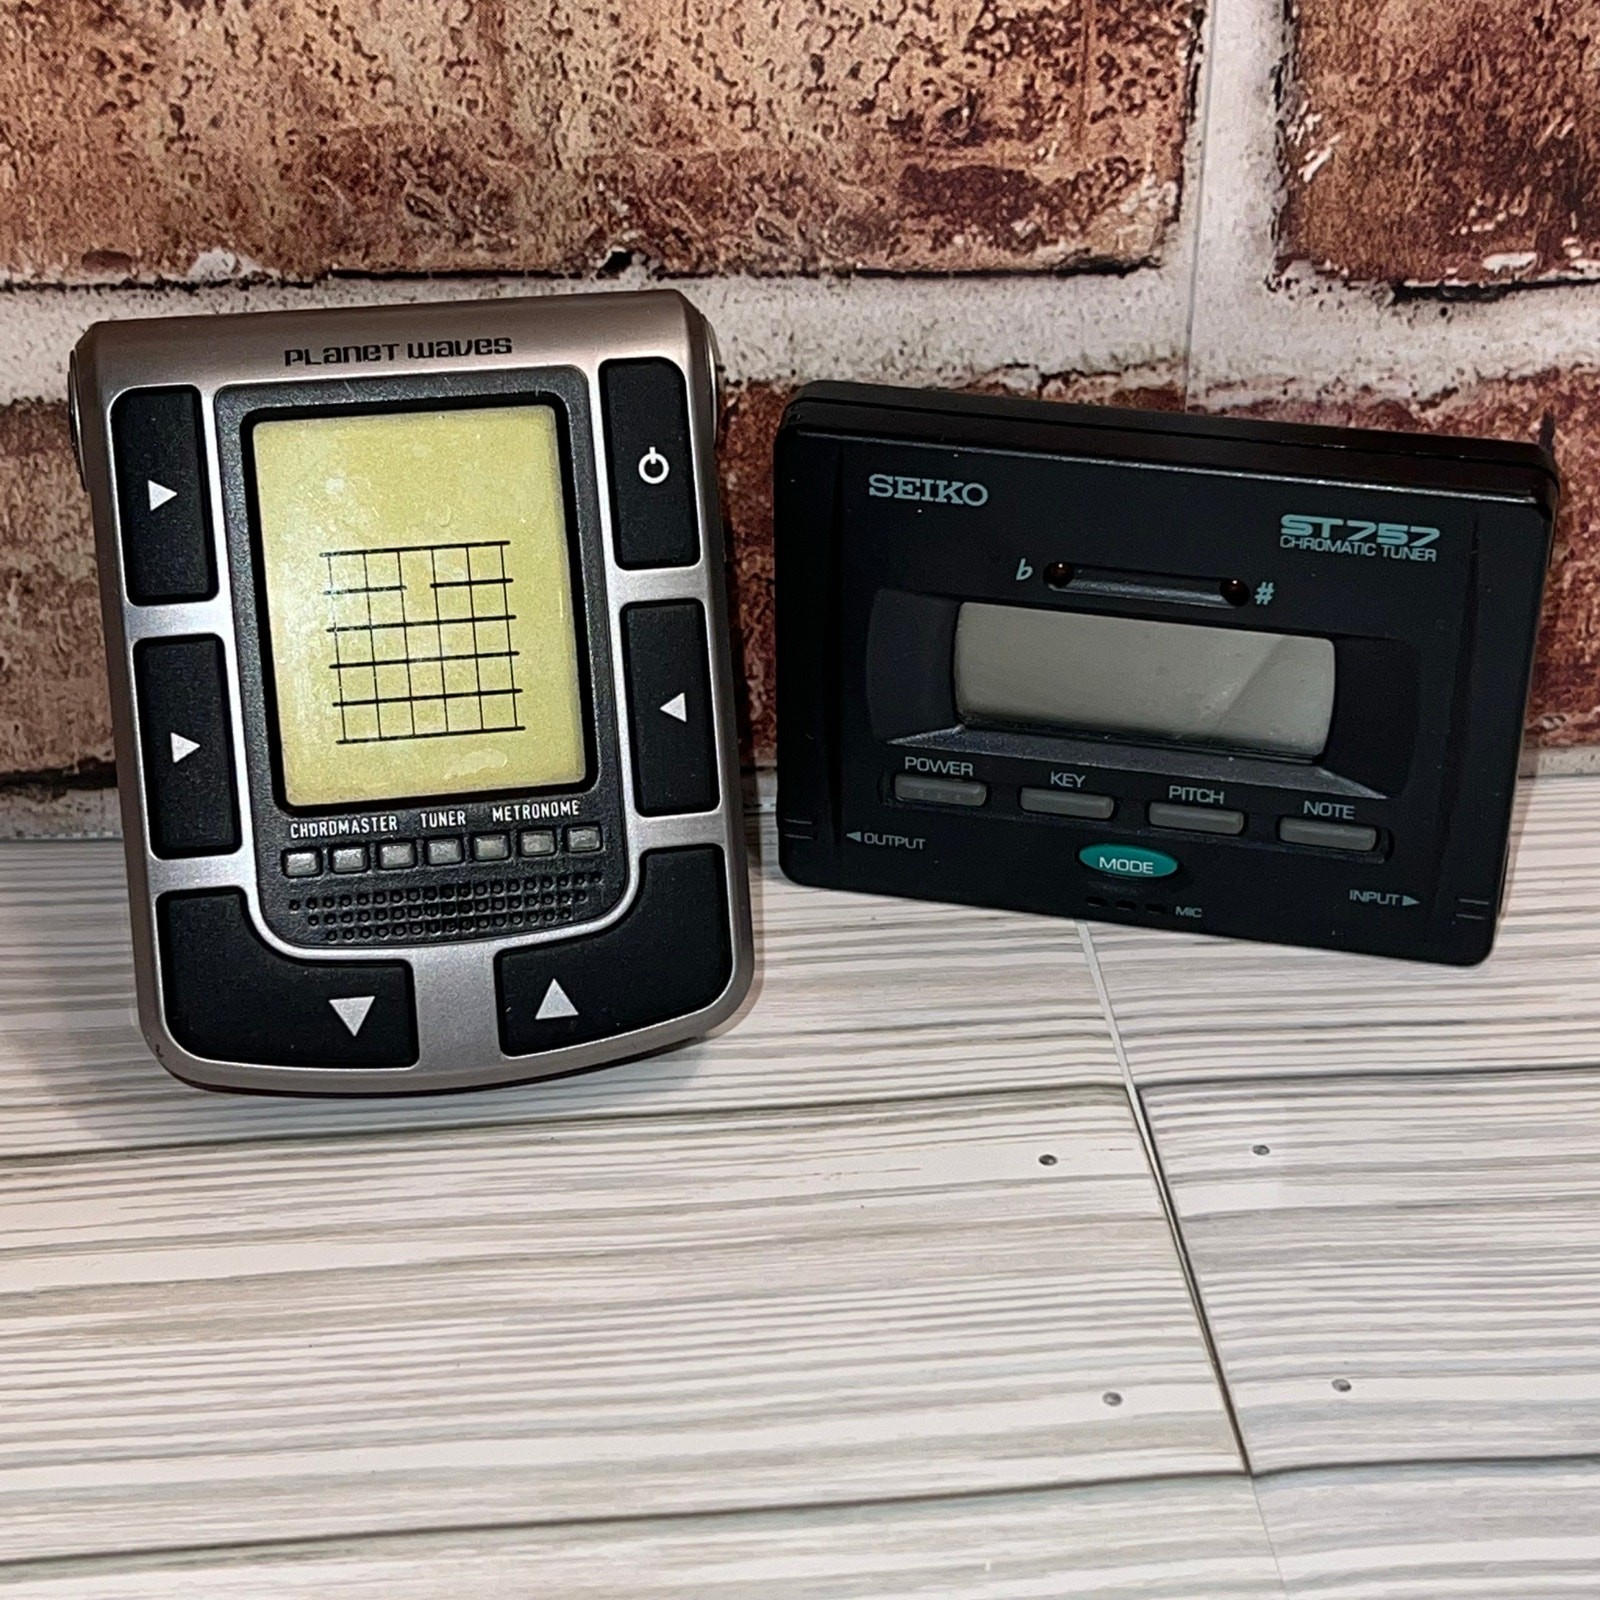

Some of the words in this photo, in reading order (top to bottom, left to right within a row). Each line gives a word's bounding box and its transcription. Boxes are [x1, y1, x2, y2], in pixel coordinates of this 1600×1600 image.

[868, 473, 989, 507] SEIKO
[1280, 514, 1440, 547] ST757
[1279, 535, 1377, 557] CHROMATIC
[1381, 546, 1437, 562] TUNER
[904, 756, 974, 777] POWER
[1050, 771, 1086, 788] KEY
[1168, 786, 1225, 804] PITCH
[420, 811, 467, 828] TUNER
[492, 800, 580, 823] METRONOME
[1303, 801, 1355, 820] NOTE
[290, 815, 398, 839] CHORDMASTER
[863, 832, 926, 850] OUTPUT
[1099, 856, 1154, 875] MODE
[1349, 889, 1400, 906] INPUT
[1175, 906, 1203, 919] MIC
